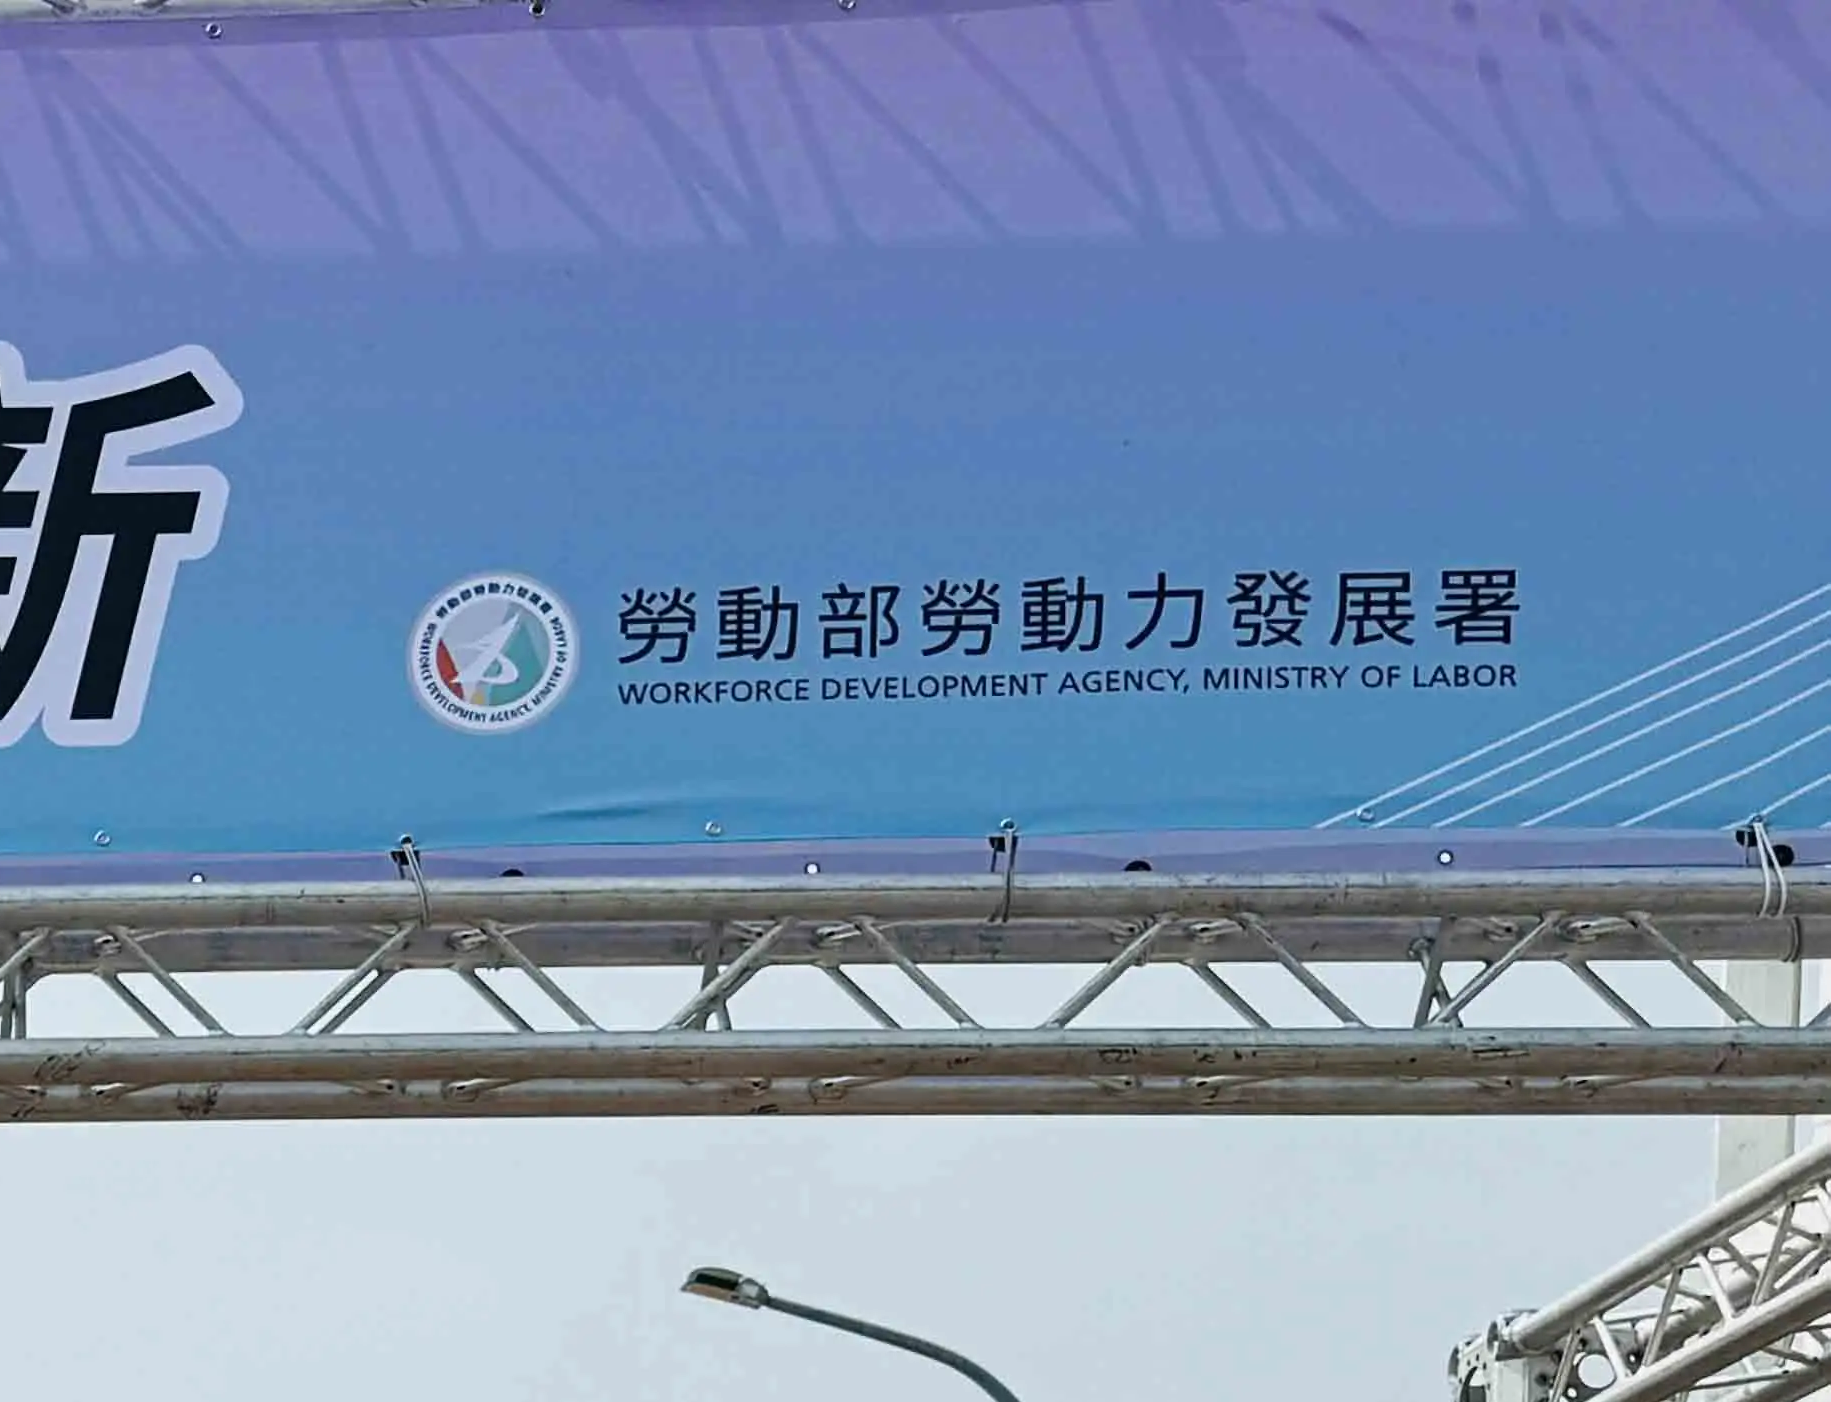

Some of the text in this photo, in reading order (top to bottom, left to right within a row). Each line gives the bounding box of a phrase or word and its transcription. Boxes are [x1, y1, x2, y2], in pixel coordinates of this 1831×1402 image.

[617, 568, 1522, 666] 勞動部勞動力發展署
[617, 663, 1518, 706] WORKFORCE DEVELOPMENT AGENCY, MINISTRY OF LABOR
